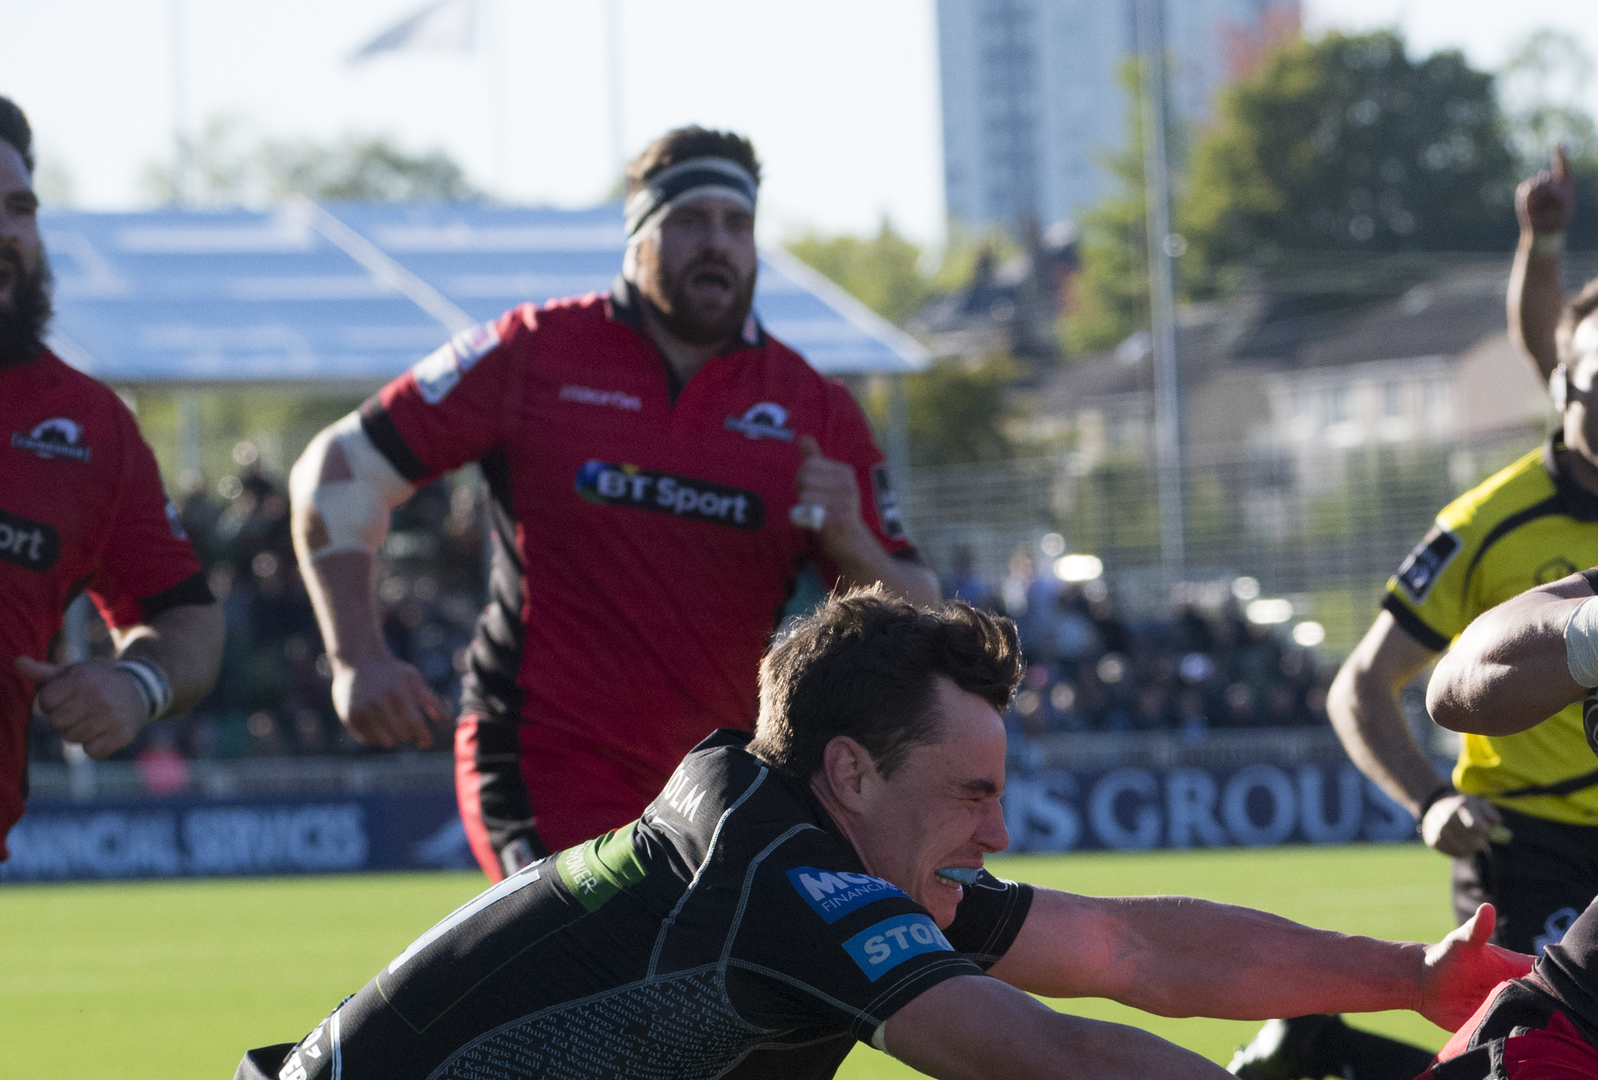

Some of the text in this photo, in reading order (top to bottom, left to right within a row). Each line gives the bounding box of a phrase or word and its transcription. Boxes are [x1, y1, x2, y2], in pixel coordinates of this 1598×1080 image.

[597, 469, 750, 524] BT Sport
[537, 1022, 617, 1060] John Barclay
[551, 1036, 620, 1072] Ed Kalman
[464, 1061, 511, 1080] Kellock
[485, 1055, 533, 1077] Jackson
[514, 1053, 541, 1070] Hall
[540, 1043, 603, 1075] Jon Welsh
[549, 1058, 590, 1080] Moray
